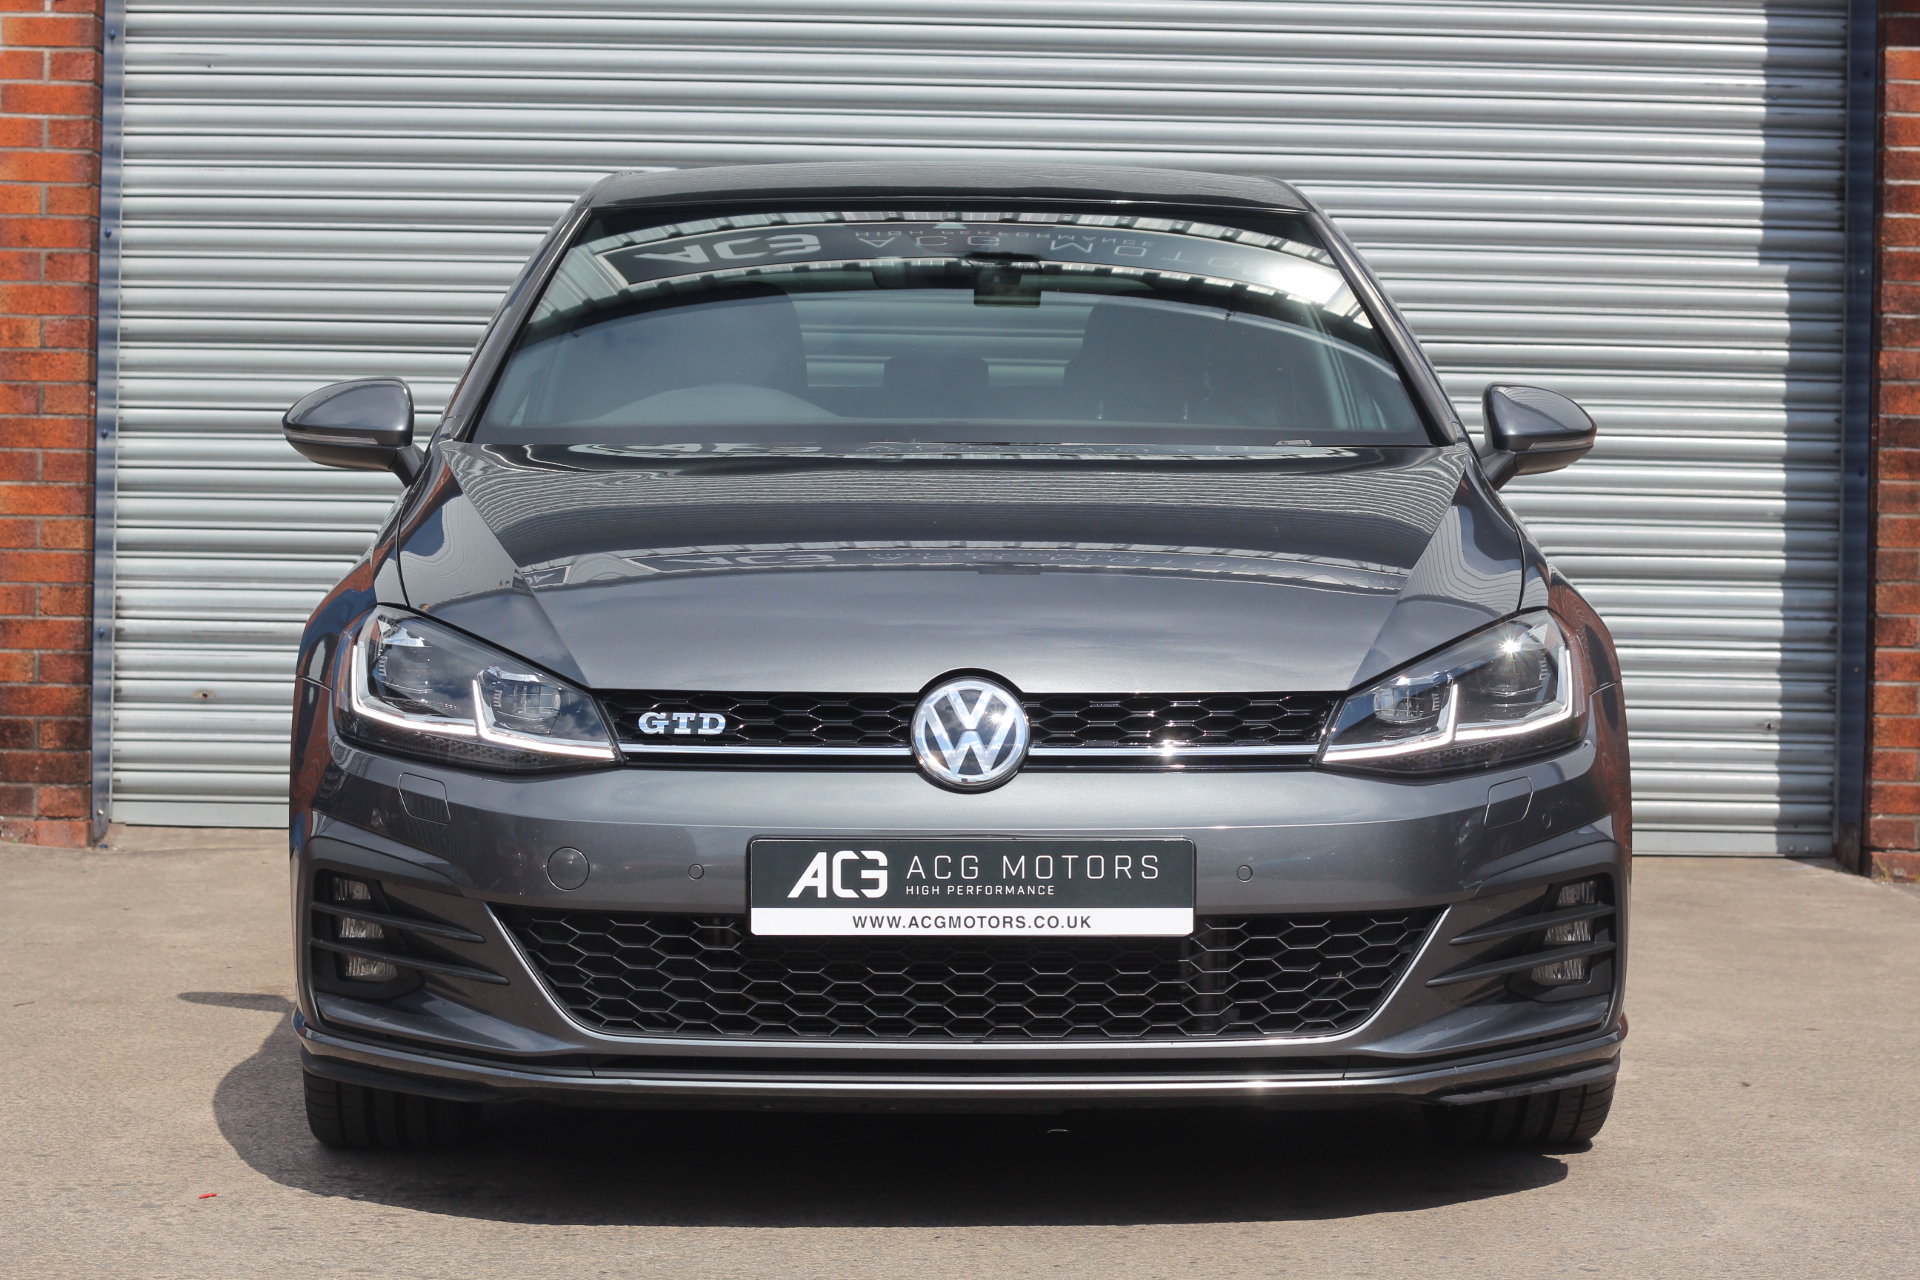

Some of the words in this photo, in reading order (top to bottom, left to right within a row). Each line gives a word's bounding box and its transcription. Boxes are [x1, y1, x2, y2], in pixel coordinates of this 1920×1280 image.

[638, 711, 727, 736] GTD
[905, 854, 980, 880] ACG
[1002, 854, 1160, 880] MOTORS
[905, 885, 941, 896] HIGH
[947, 885, 1056, 896] PERFORMANCE
[852, 914, 1093, 930] WWW.ACGMOTORS.CO.UK
